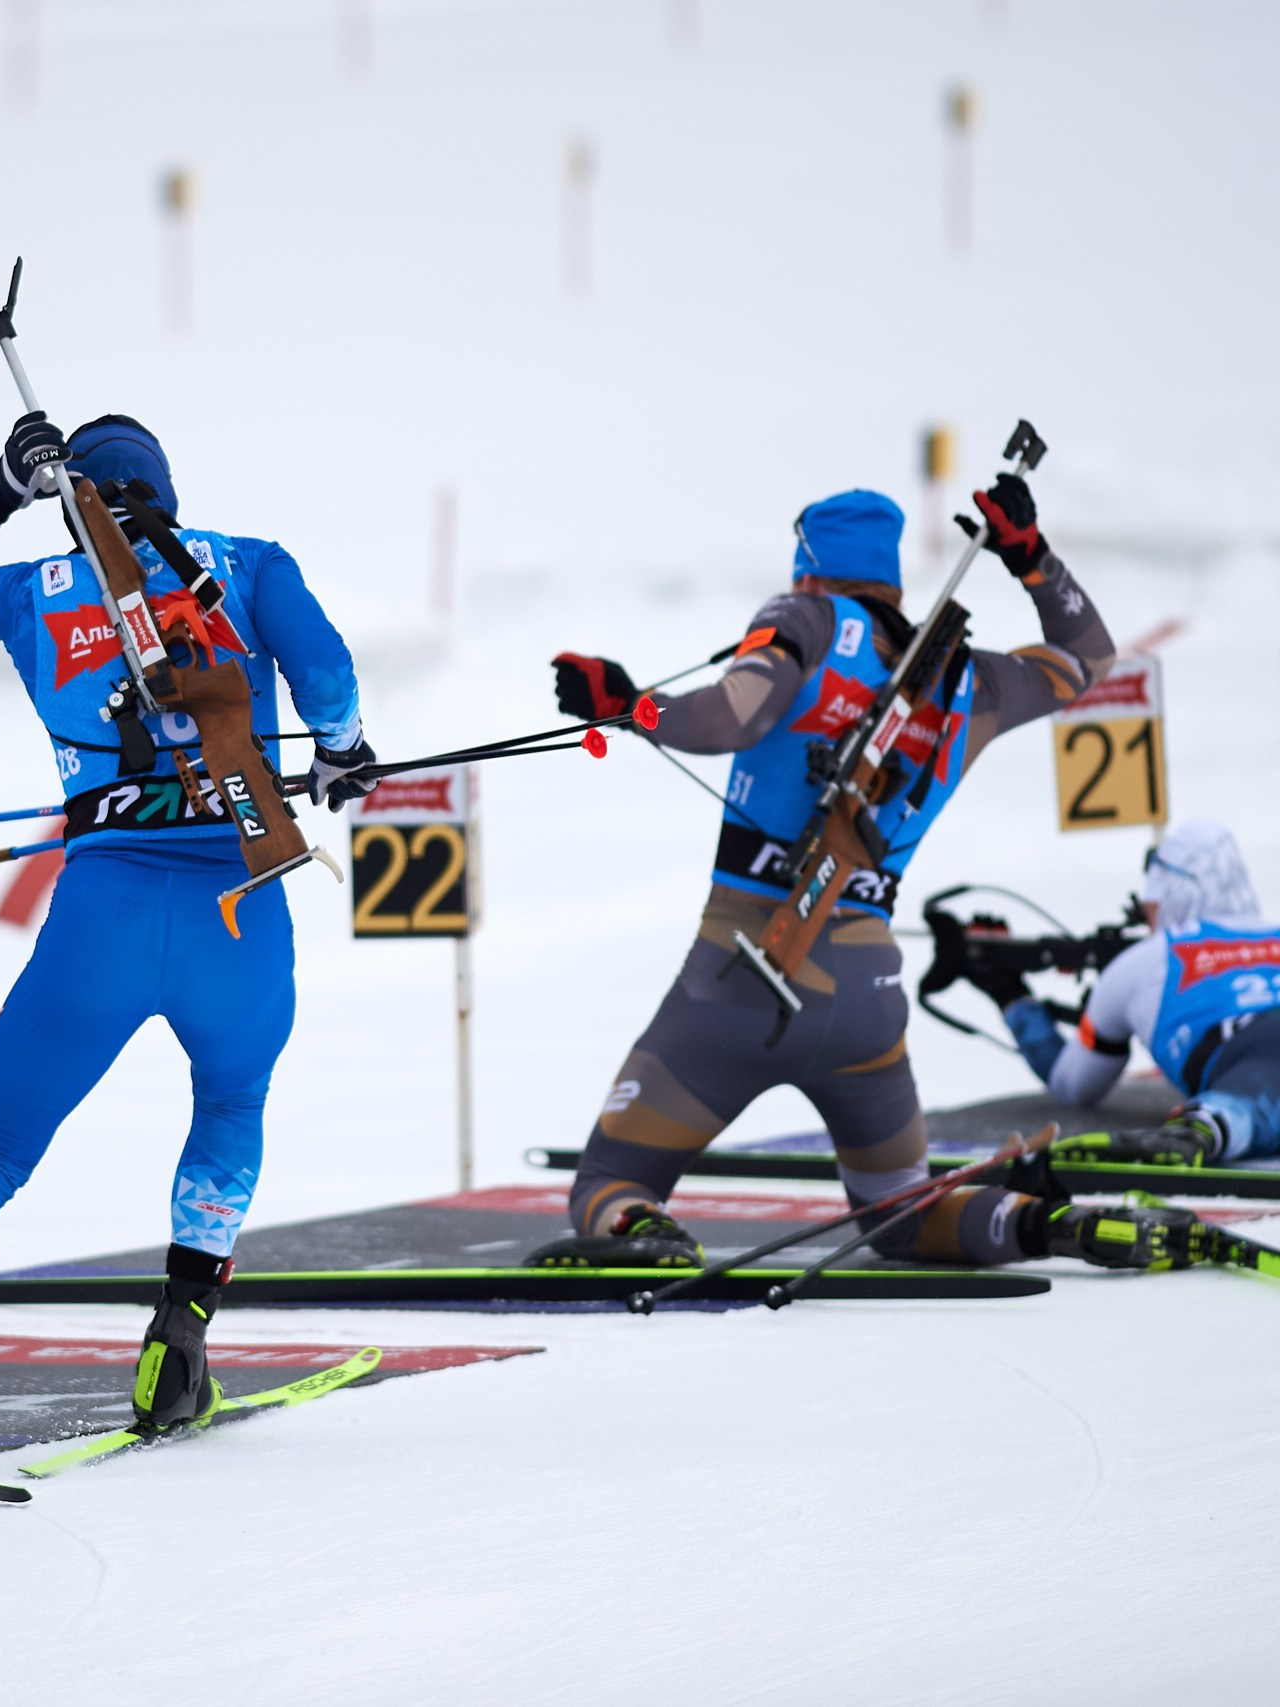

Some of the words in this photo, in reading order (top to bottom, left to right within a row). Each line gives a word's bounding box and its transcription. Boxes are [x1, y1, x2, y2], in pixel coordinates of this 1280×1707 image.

[70, 624, 117, 650] Аль
[57, 746, 81, 780] 28
[1065, 717, 1157, 820] 21
[94, 779, 225, 824] PAR
[223, 775, 266, 837] PARI
[353, 824, 467, 931] 22
[749, 842, 891, 902] PRI
[288, 1368, 348, 1394] FISCHER
